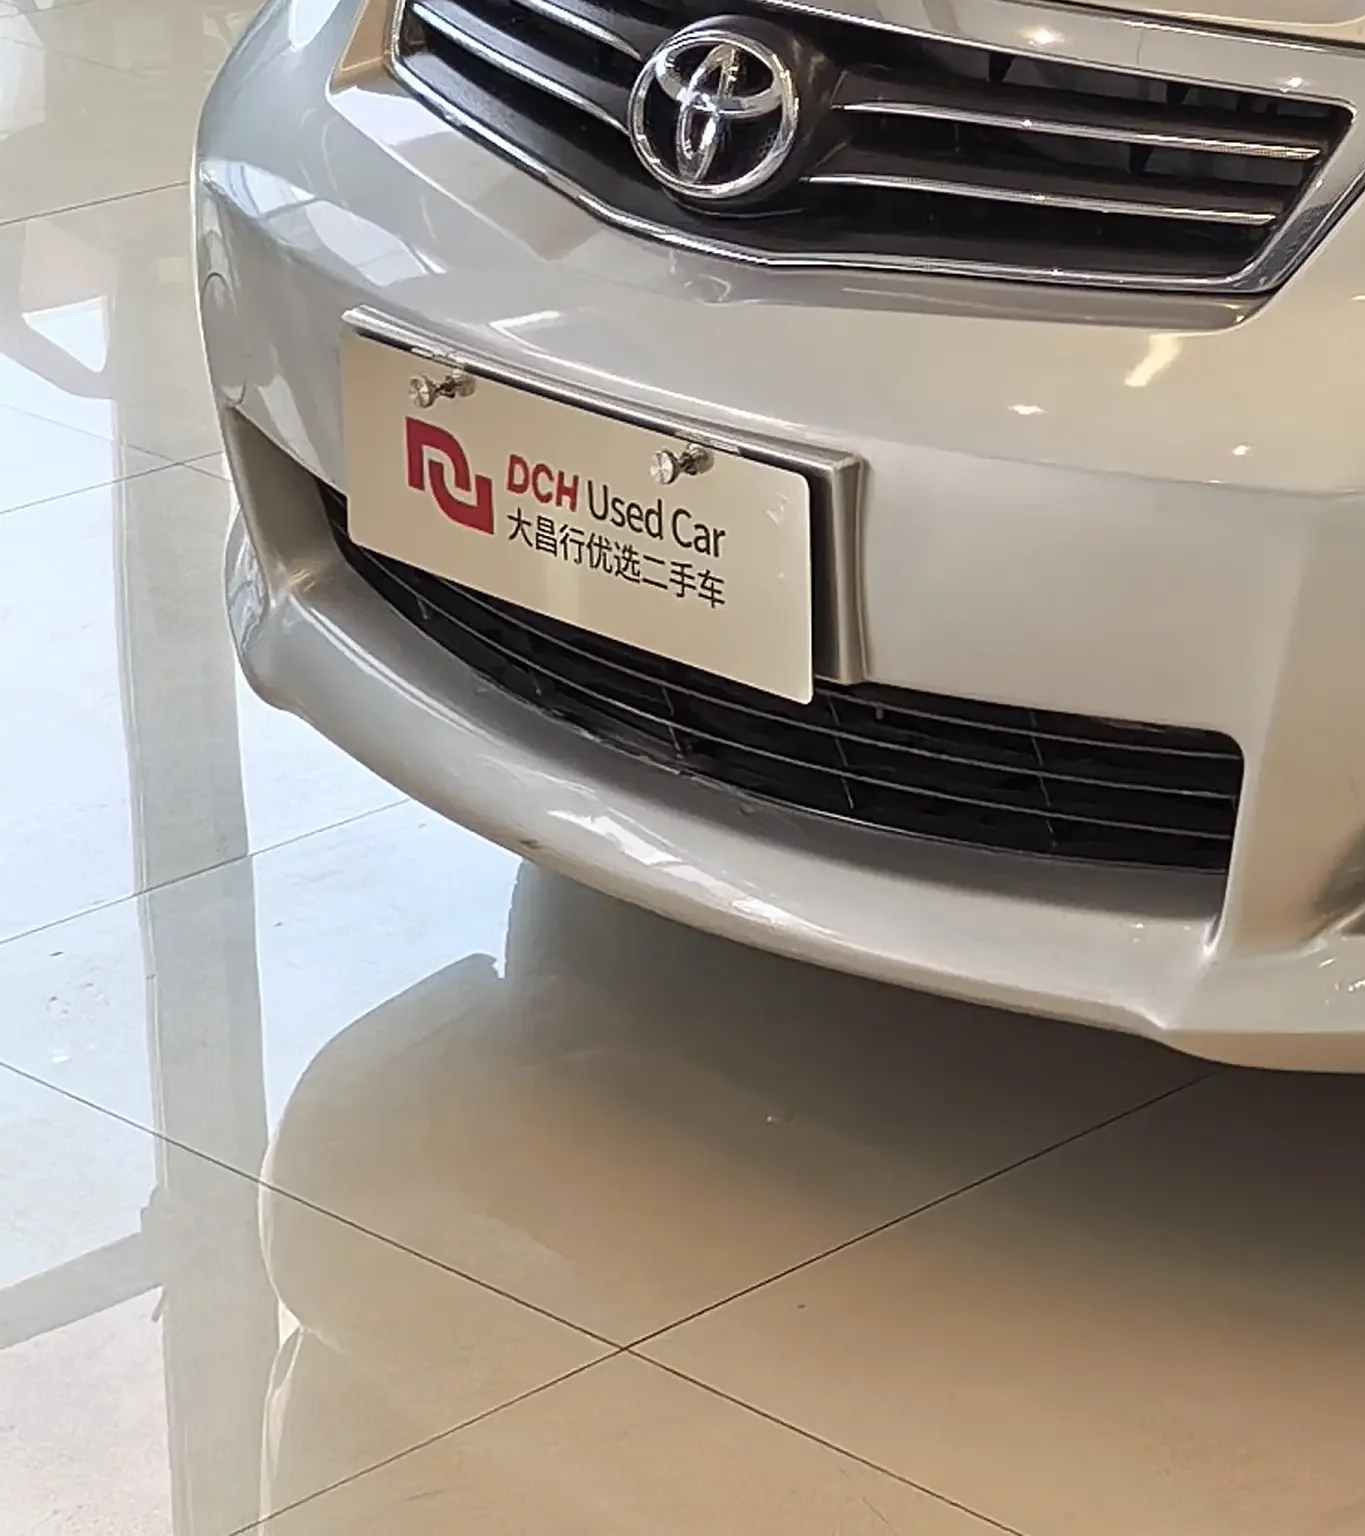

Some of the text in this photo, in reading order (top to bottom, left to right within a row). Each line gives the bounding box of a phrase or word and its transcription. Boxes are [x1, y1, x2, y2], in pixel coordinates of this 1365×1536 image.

[506, 453, 726, 558] DCH Used Car
[506, 506, 726, 609] 大昌行优选二手车
